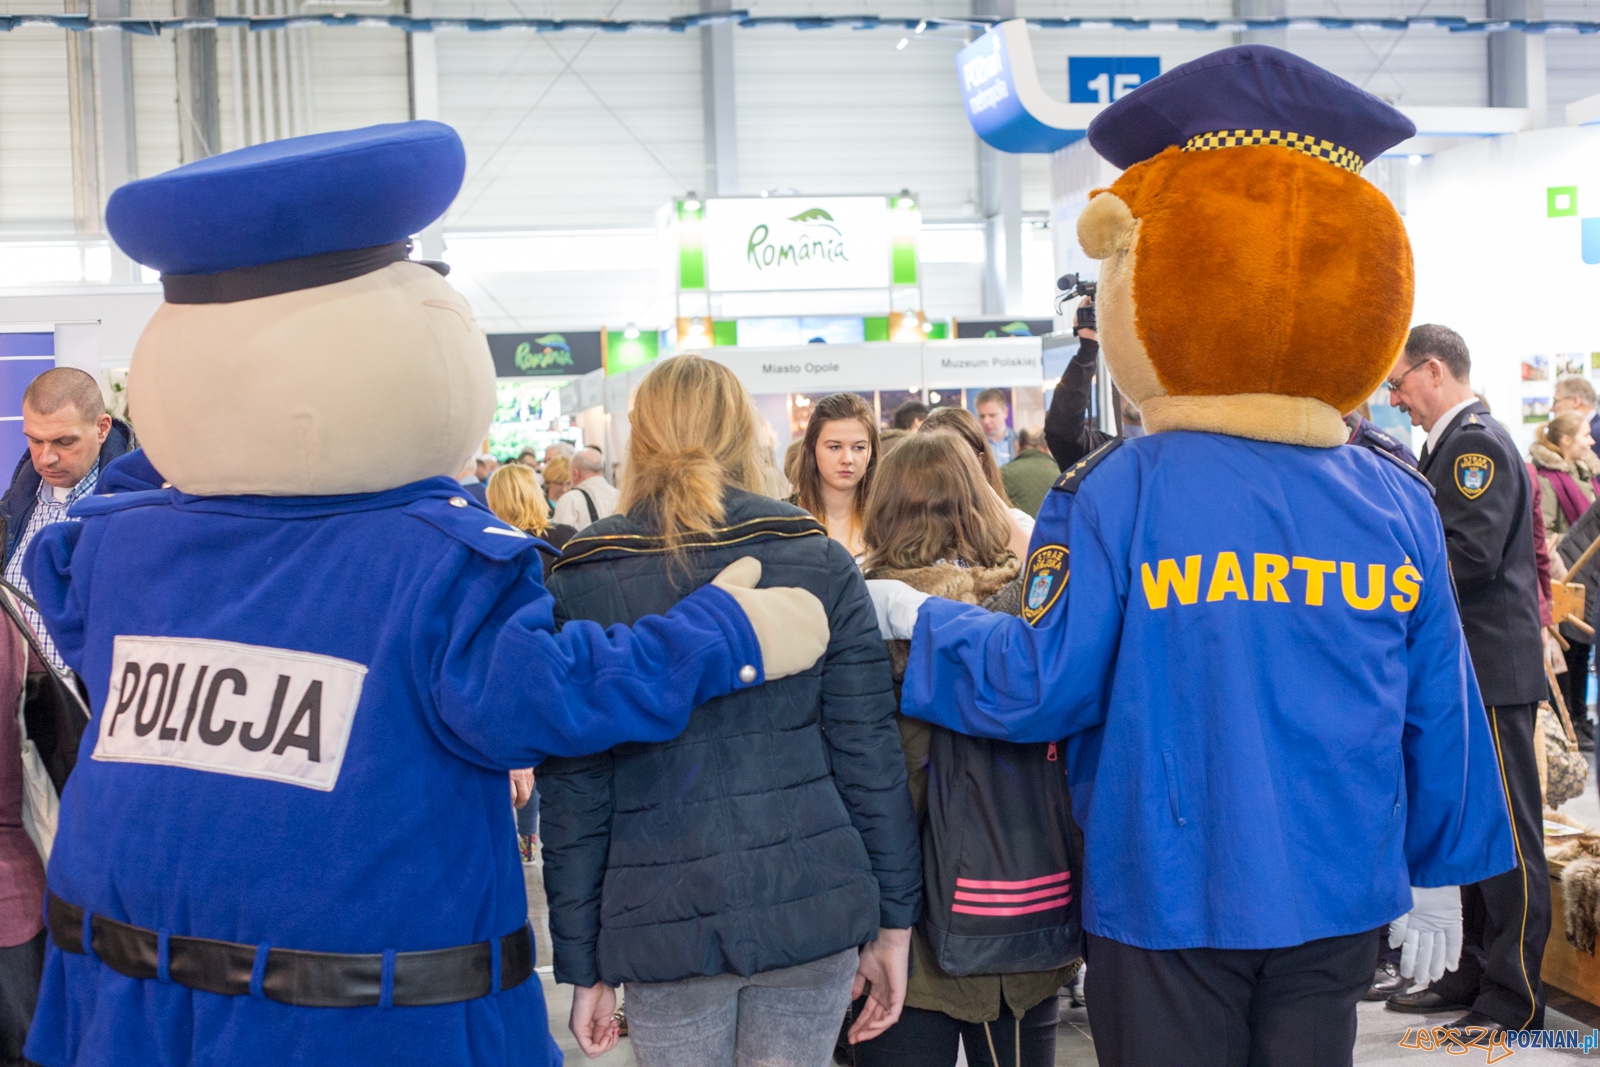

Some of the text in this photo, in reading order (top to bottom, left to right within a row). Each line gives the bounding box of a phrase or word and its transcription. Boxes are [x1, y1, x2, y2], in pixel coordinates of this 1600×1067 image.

[762, 362, 840, 375] Miasto Opole
[941, 355, 1036, 369] Muzeum Polskiej
[1140, 551, 1424, 613] WARTUŚ
[108, 661, 323, 763] POLICJA
